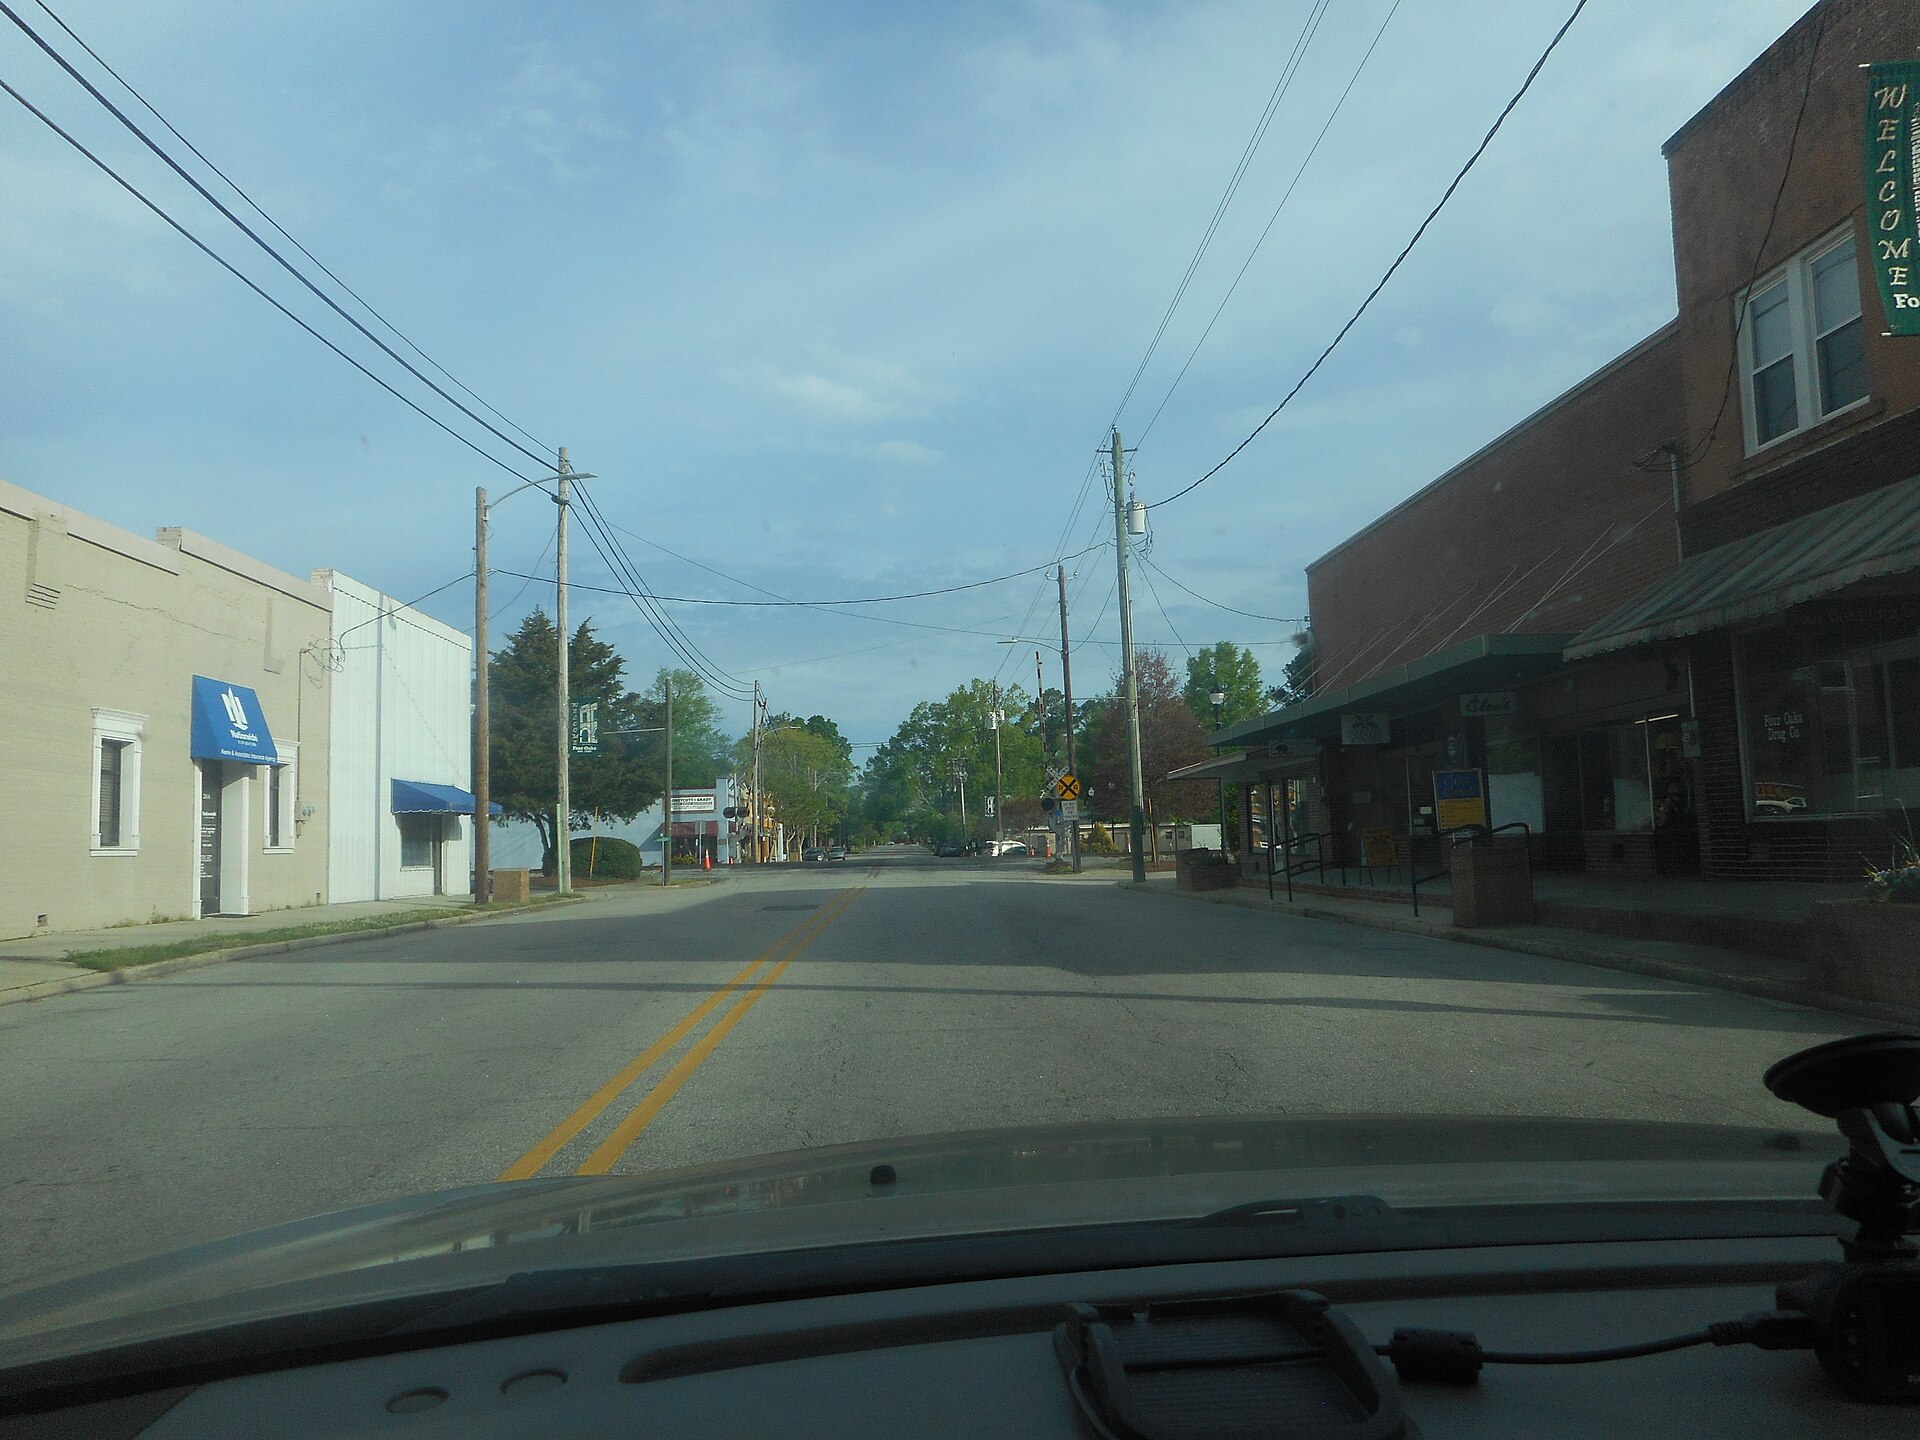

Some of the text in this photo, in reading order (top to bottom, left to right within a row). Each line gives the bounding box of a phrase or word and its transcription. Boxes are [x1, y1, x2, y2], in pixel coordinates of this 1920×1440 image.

[1873, 84, 1912, 287] WELCOME
[1893, 293, 1920, 309] Fo
[571, 702, 579, 746] WELCOME
[1763, 711, 1803, 728] Four Oaks
[230, 730, 258, 742] Nationwide
[1768, 728, 1787, 743] Drug
